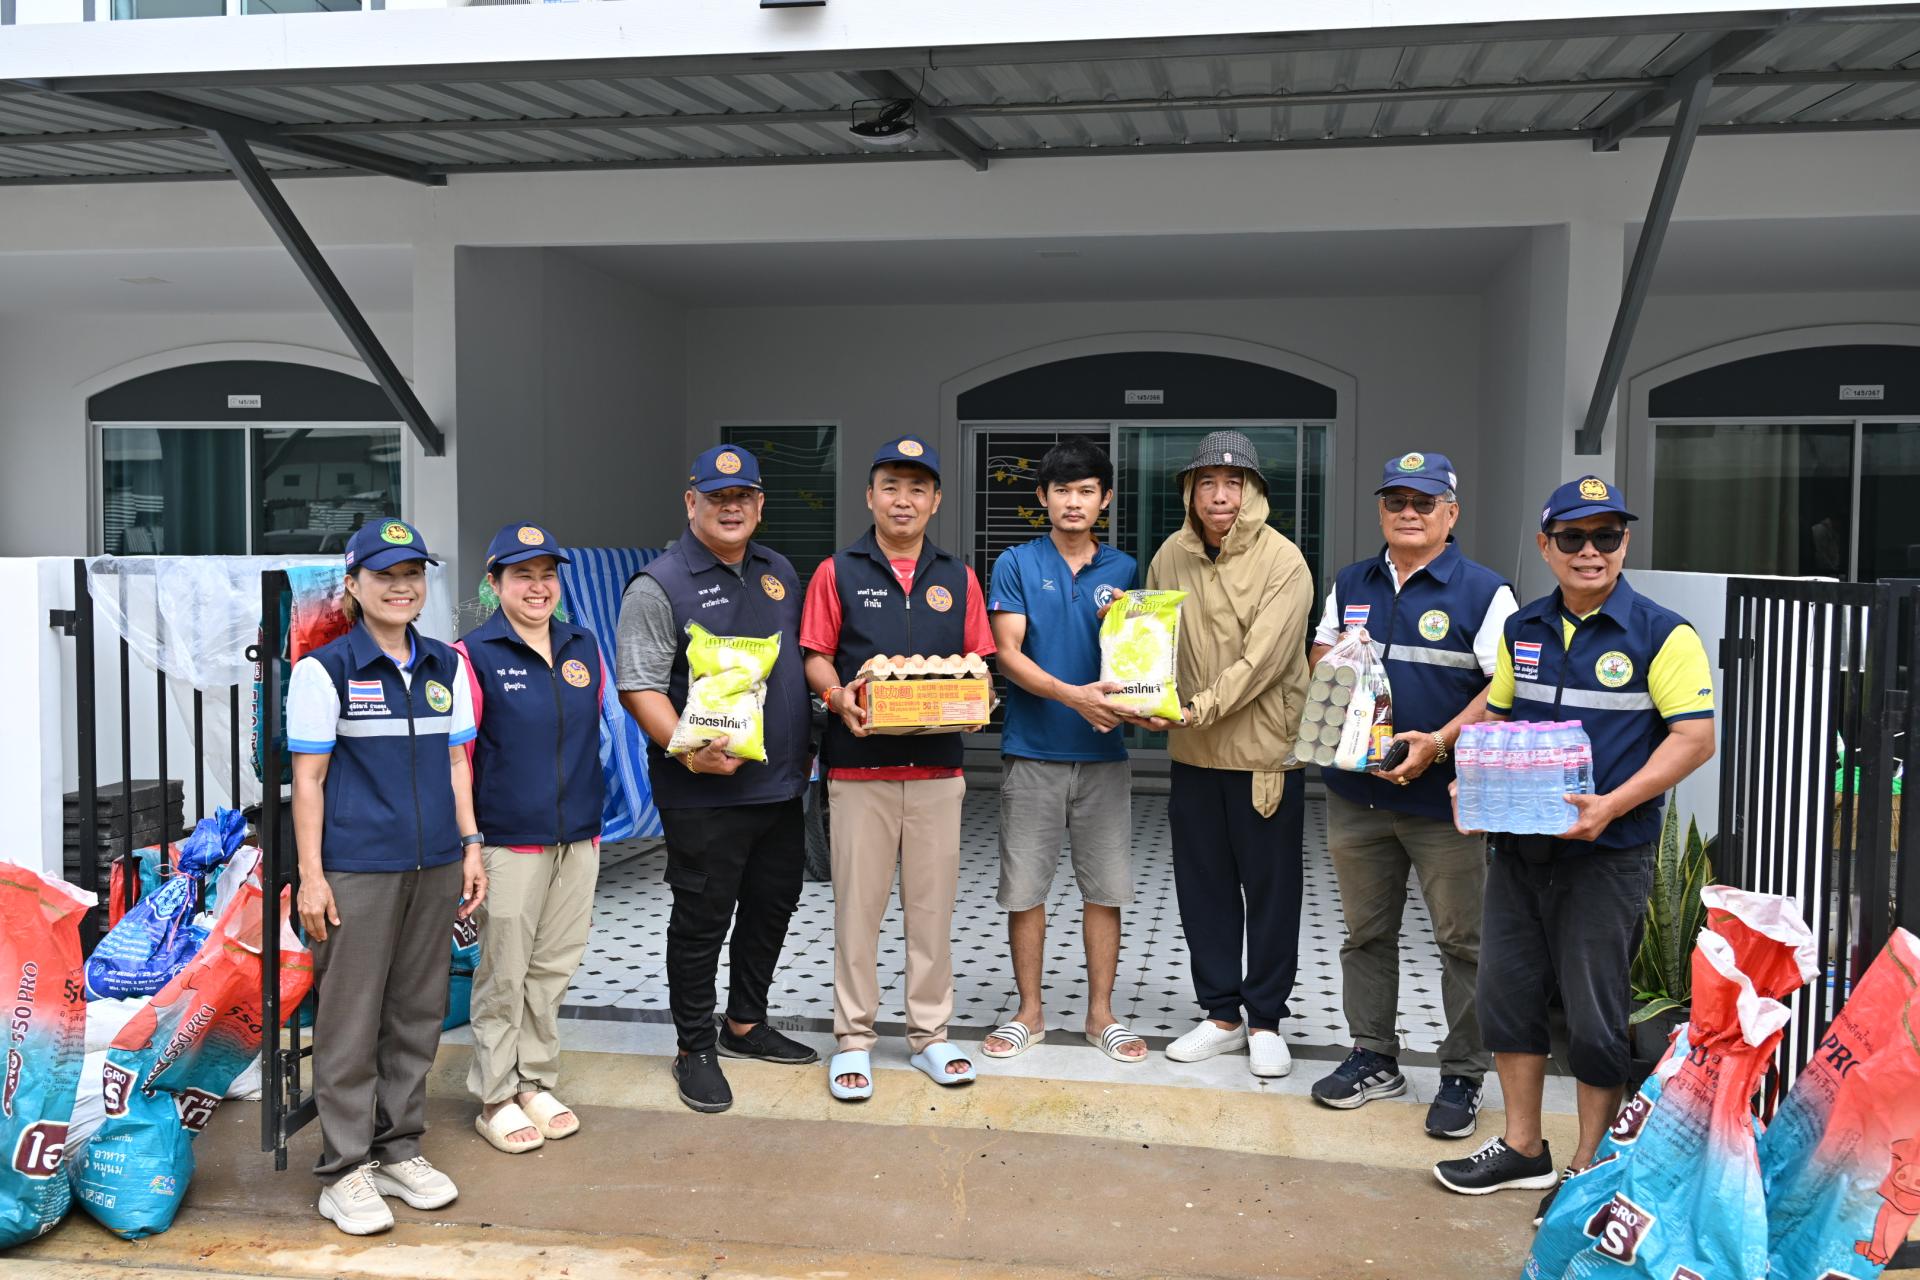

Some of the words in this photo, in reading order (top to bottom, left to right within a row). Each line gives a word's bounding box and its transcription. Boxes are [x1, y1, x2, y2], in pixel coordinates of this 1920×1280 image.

[689, 713, 748, 730] ข้าวตราไก่แจ้
[17, 961, 38, 1002] PRO
[12, 1006, 32, 1046] 550
[164, 1031, 193, 1061] 550
[186, 1003, 217, 1036] PRO
[93, 1161, 123, 1178] หมูนม
[94, 1149, 127, 1163] อาหาร
[1600, 1219, 1628, 1256] S
